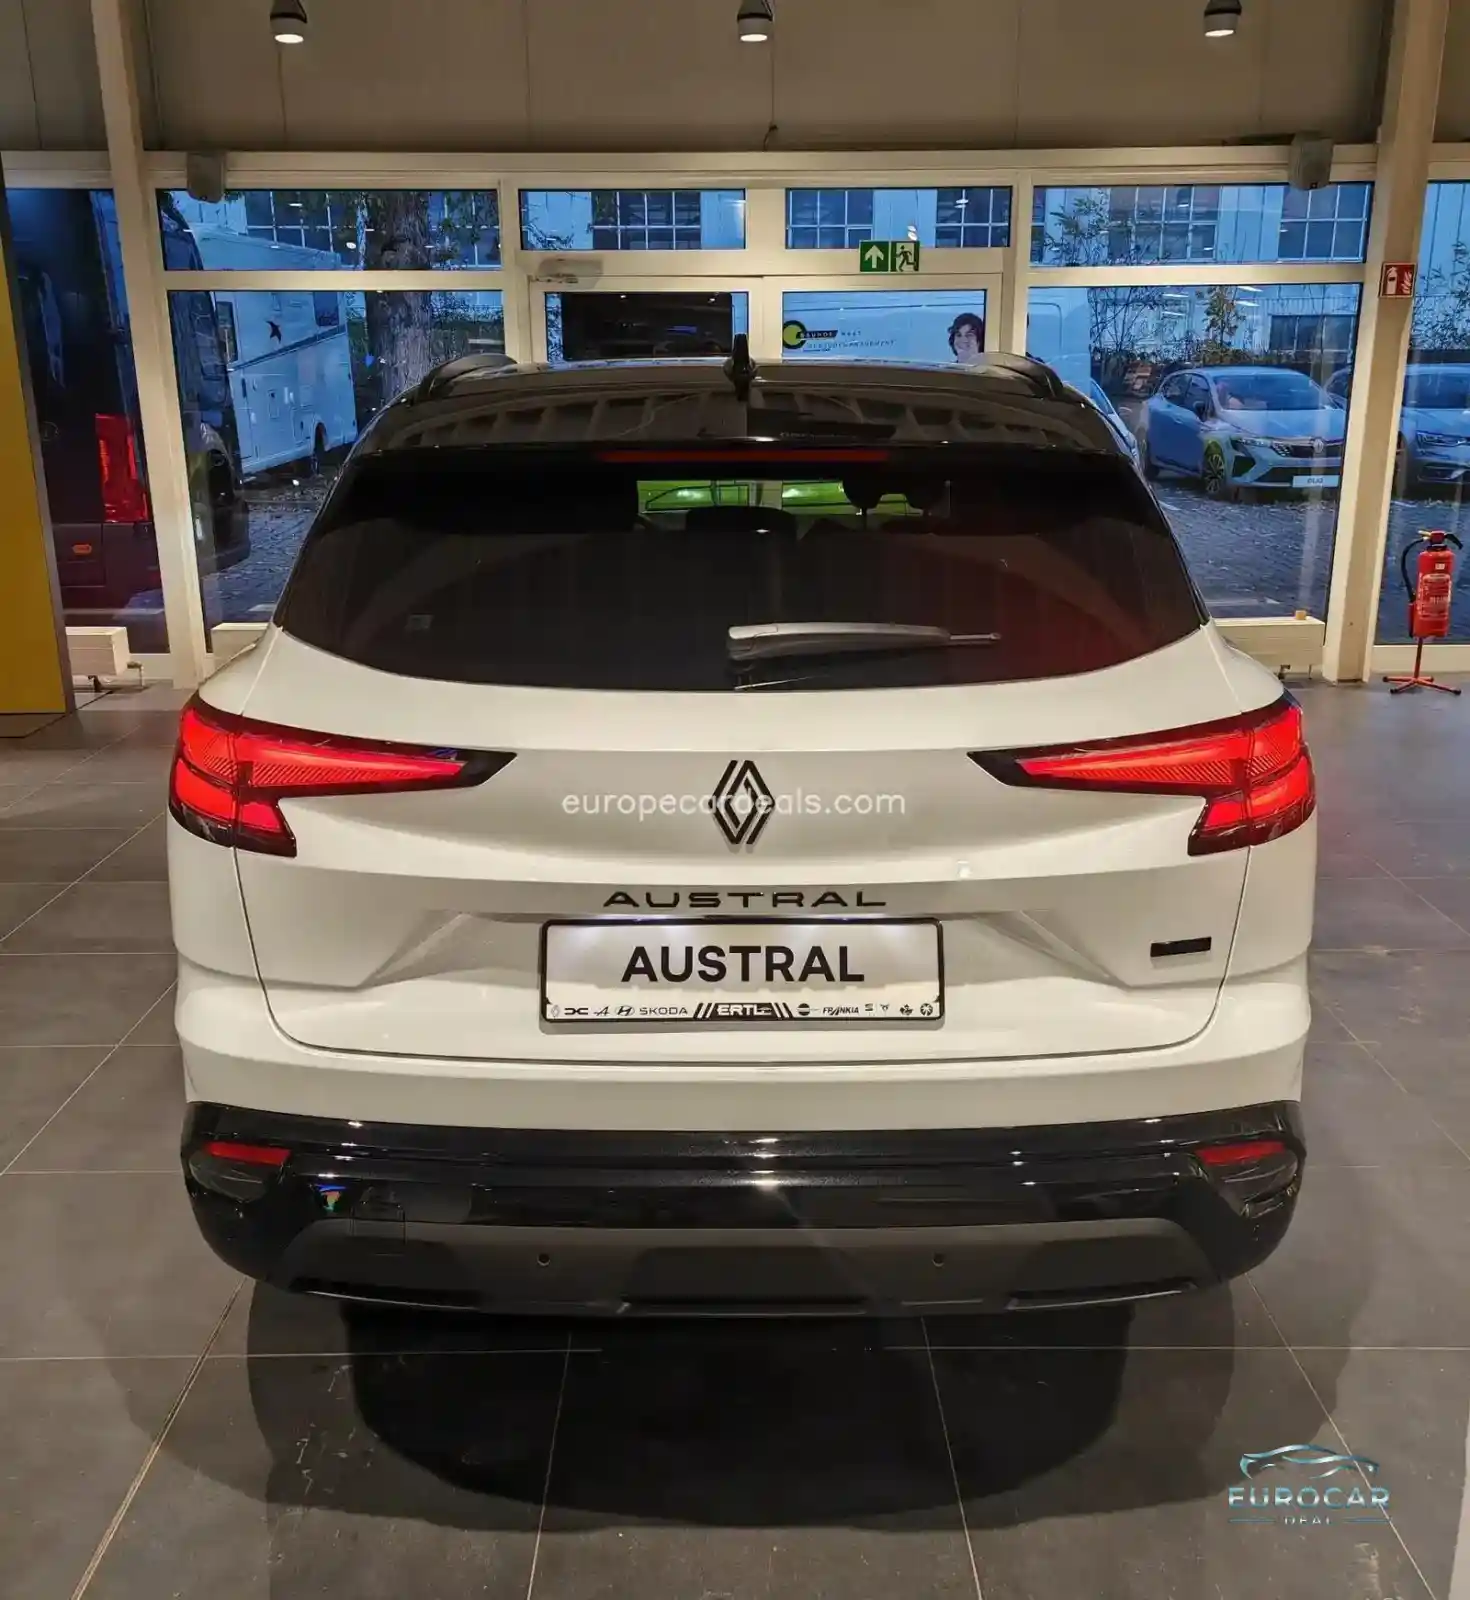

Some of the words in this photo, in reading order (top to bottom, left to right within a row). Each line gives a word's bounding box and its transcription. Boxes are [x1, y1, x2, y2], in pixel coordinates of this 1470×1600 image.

[603, 892, 887, 908] AUSTRAL
[621, 946, 866, 983] AUSTRAL
[823, 1007, 860, 1015] FRANKIA
